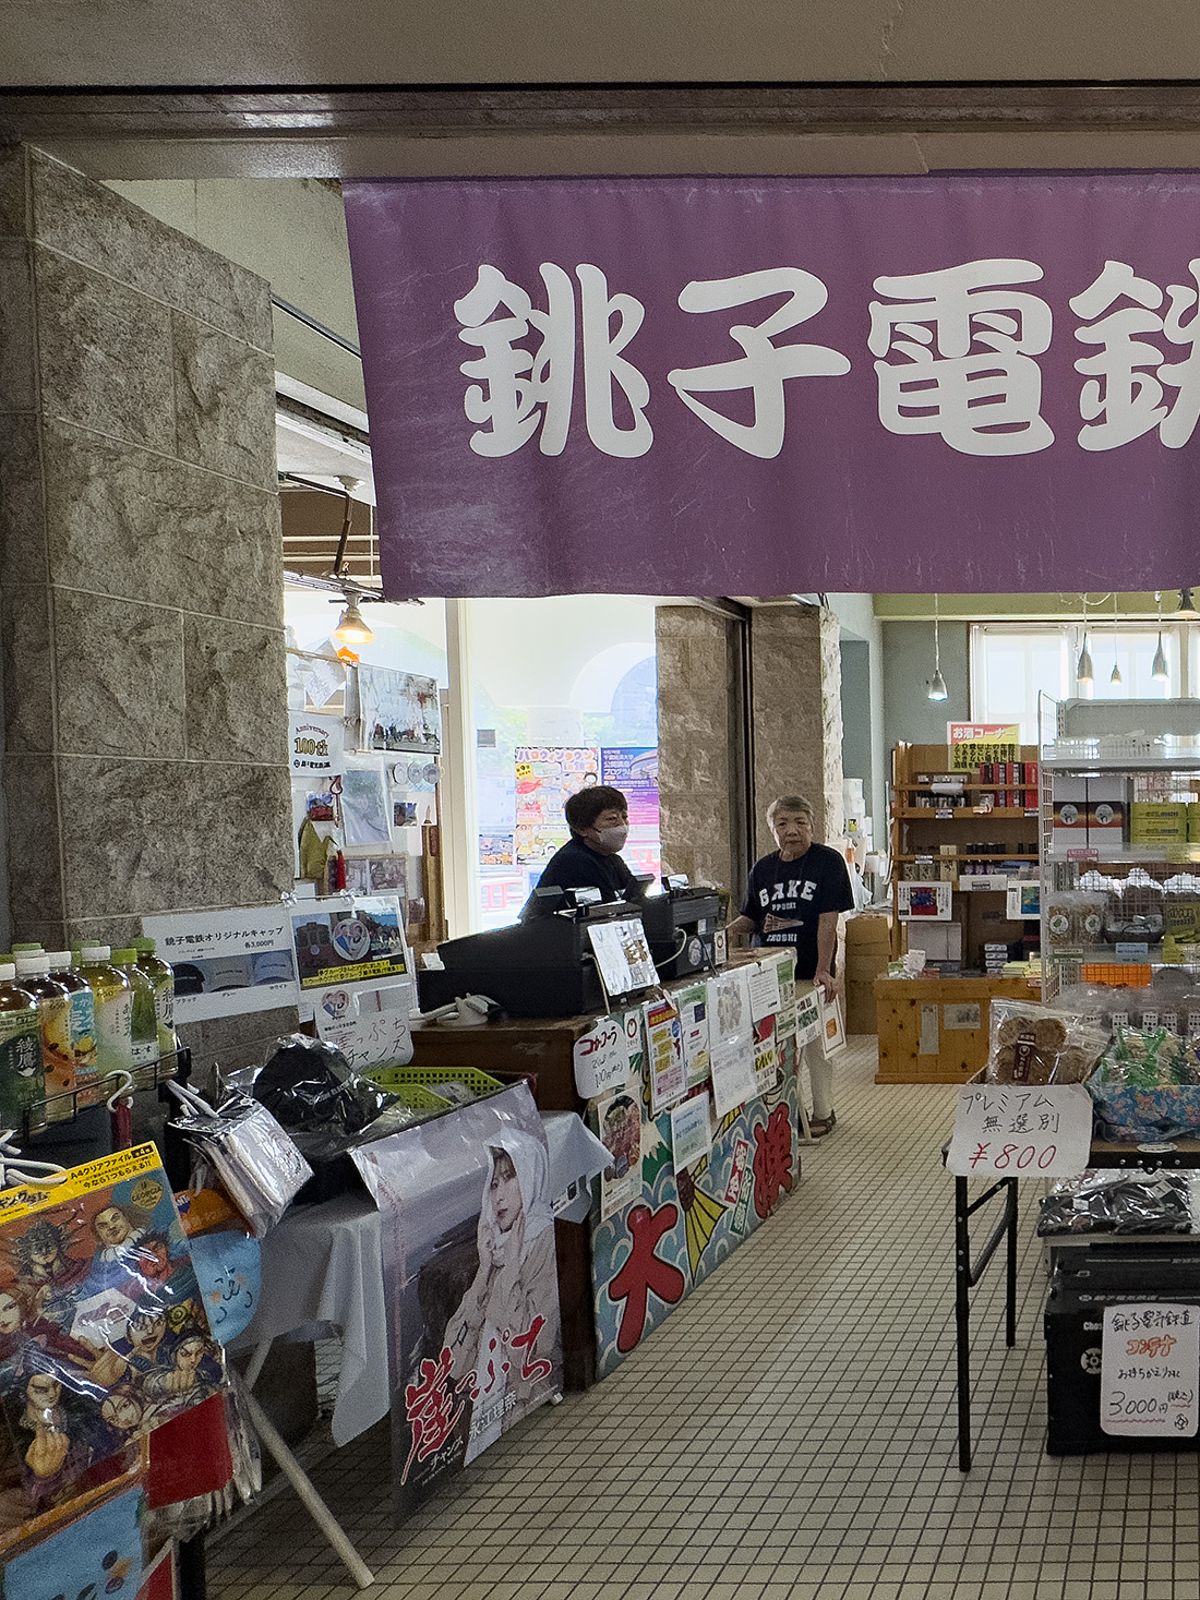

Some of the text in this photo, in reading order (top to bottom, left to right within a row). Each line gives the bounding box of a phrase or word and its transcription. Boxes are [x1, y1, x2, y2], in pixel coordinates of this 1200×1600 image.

[759, 880, 817, 907] GAKE
[962, 1092, 1055, 1115] プレミアム
[982, 1112, 1060, 1134] 無選別
[969, 1142, 1057, 1169] ¥800
[401, 1314, 553, 1487] 崖っぷち
